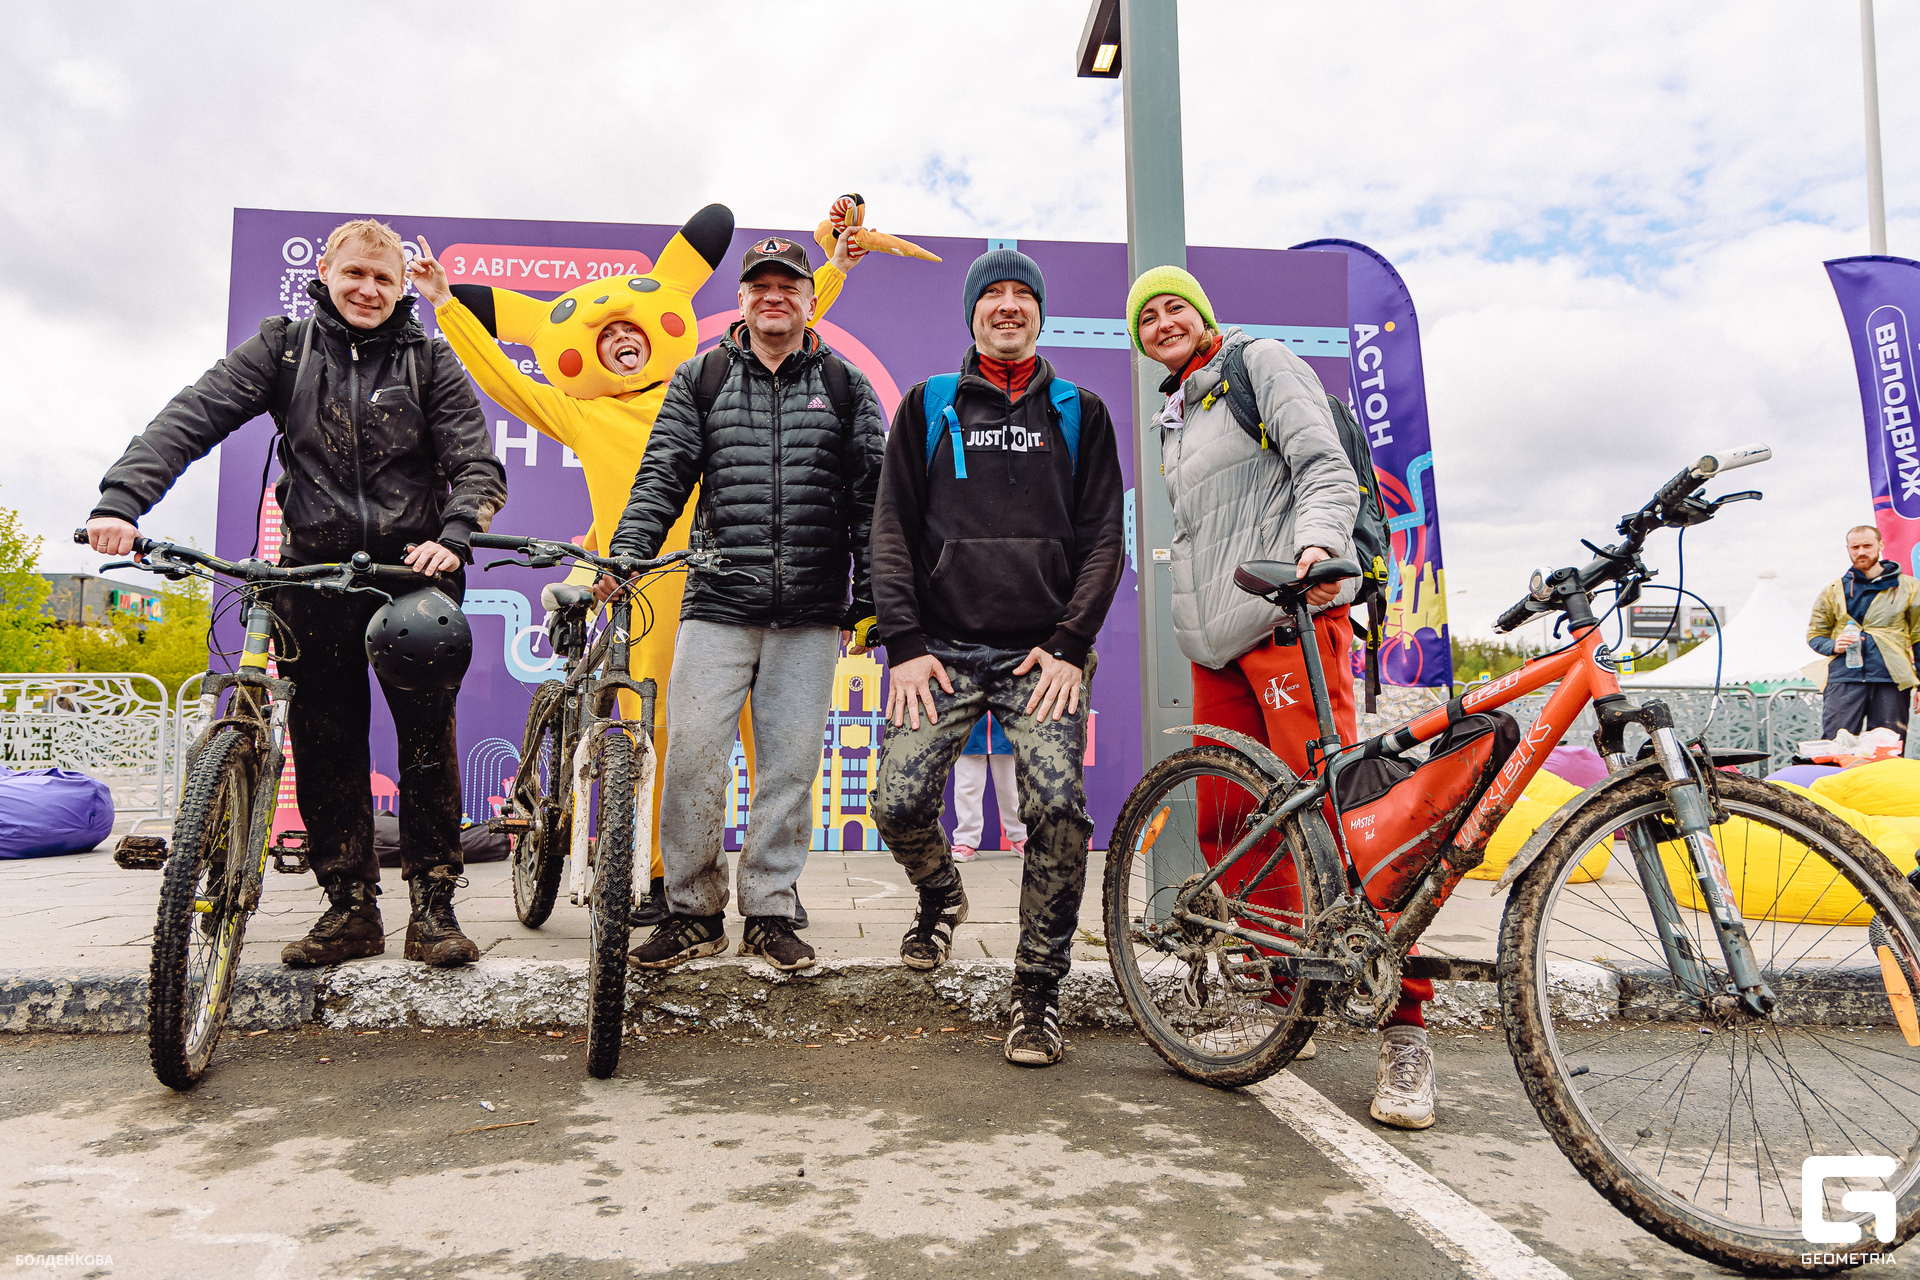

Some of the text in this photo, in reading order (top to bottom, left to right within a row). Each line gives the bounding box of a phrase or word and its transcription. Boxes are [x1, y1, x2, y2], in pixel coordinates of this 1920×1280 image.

[453, 256, 641, 280] 3 АВГУСТА 2024
[1353, 323, 1394, 449] АСТОН
[1875, 322, 1920, 502] ВЕЛОДВИЖ
[966, 430, 1044, 447] JUST DO IT.
[1350, 814, 1376, 830] MASTER
